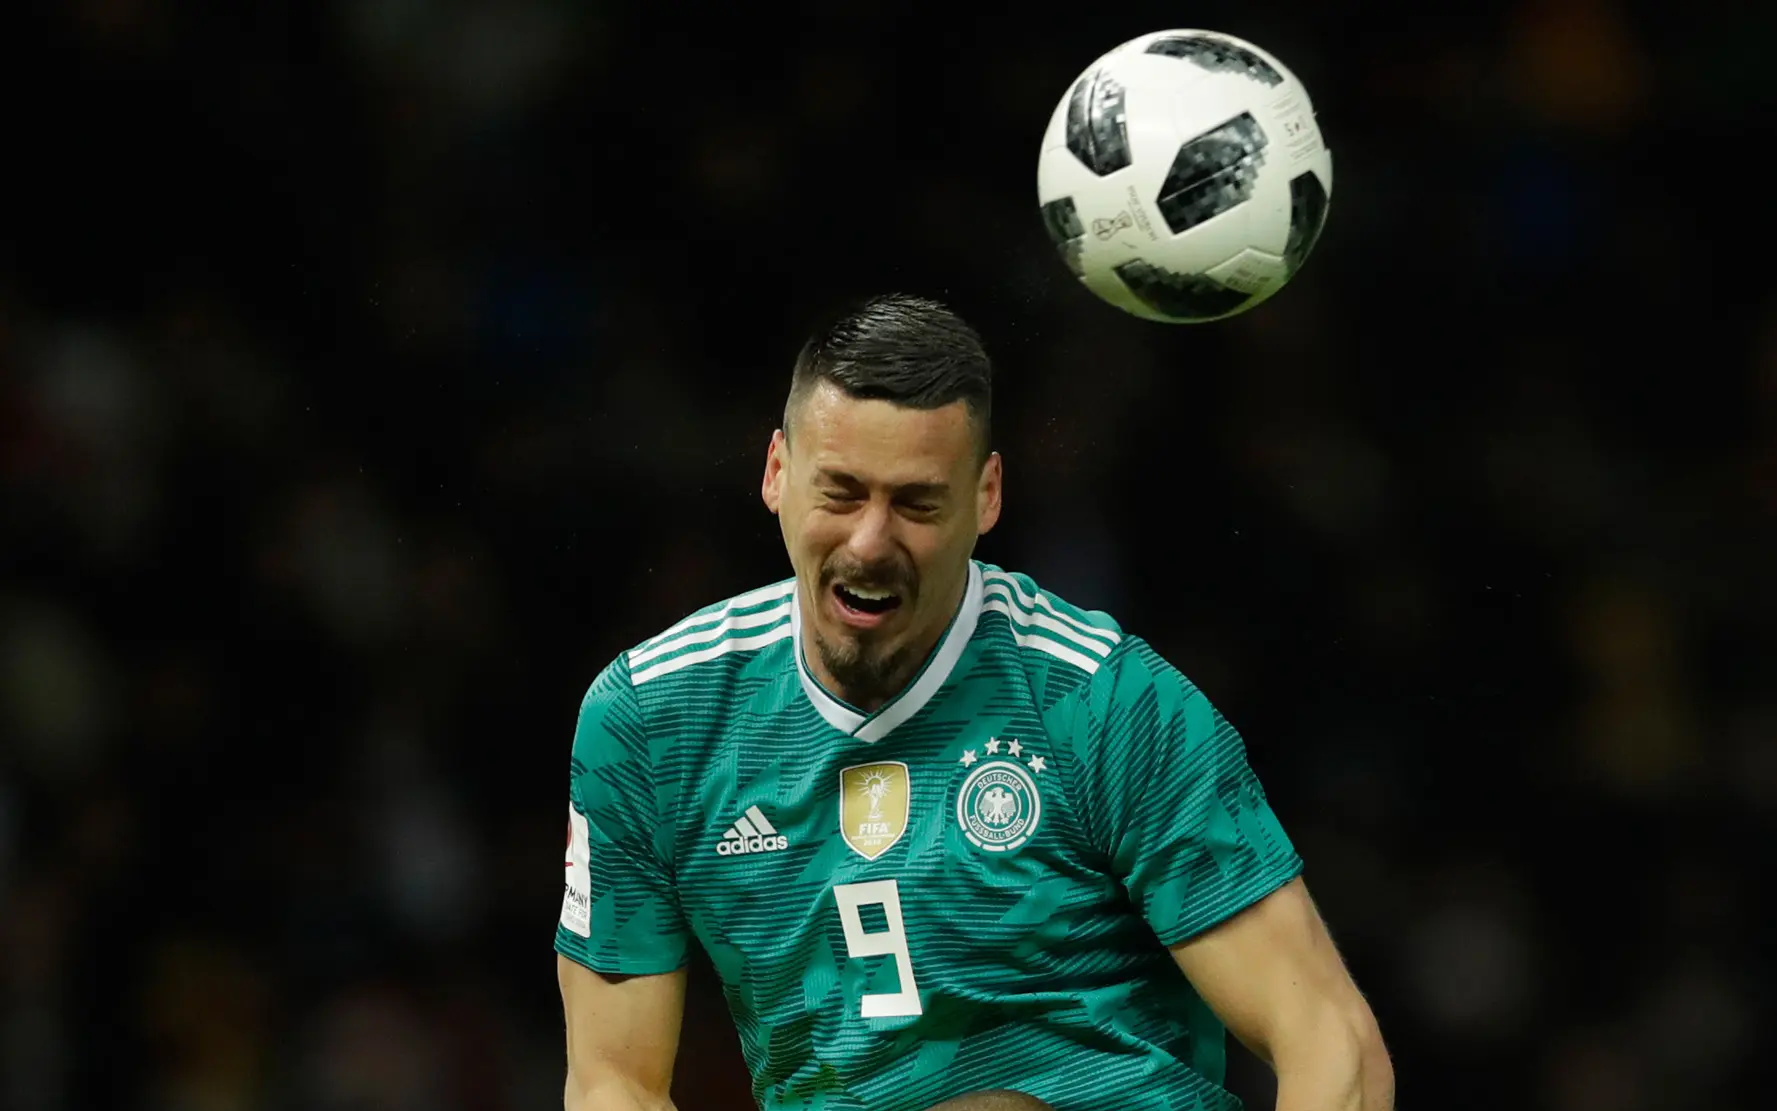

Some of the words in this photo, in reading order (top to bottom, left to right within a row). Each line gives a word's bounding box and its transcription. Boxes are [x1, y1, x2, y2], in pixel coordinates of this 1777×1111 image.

[976, 773, 1022, 791] DEUTSCHER
[859, 822, 888, 835] FIFA
[716, 834, 788, 855] adidas
[833, 879, 923, 1018] 9
